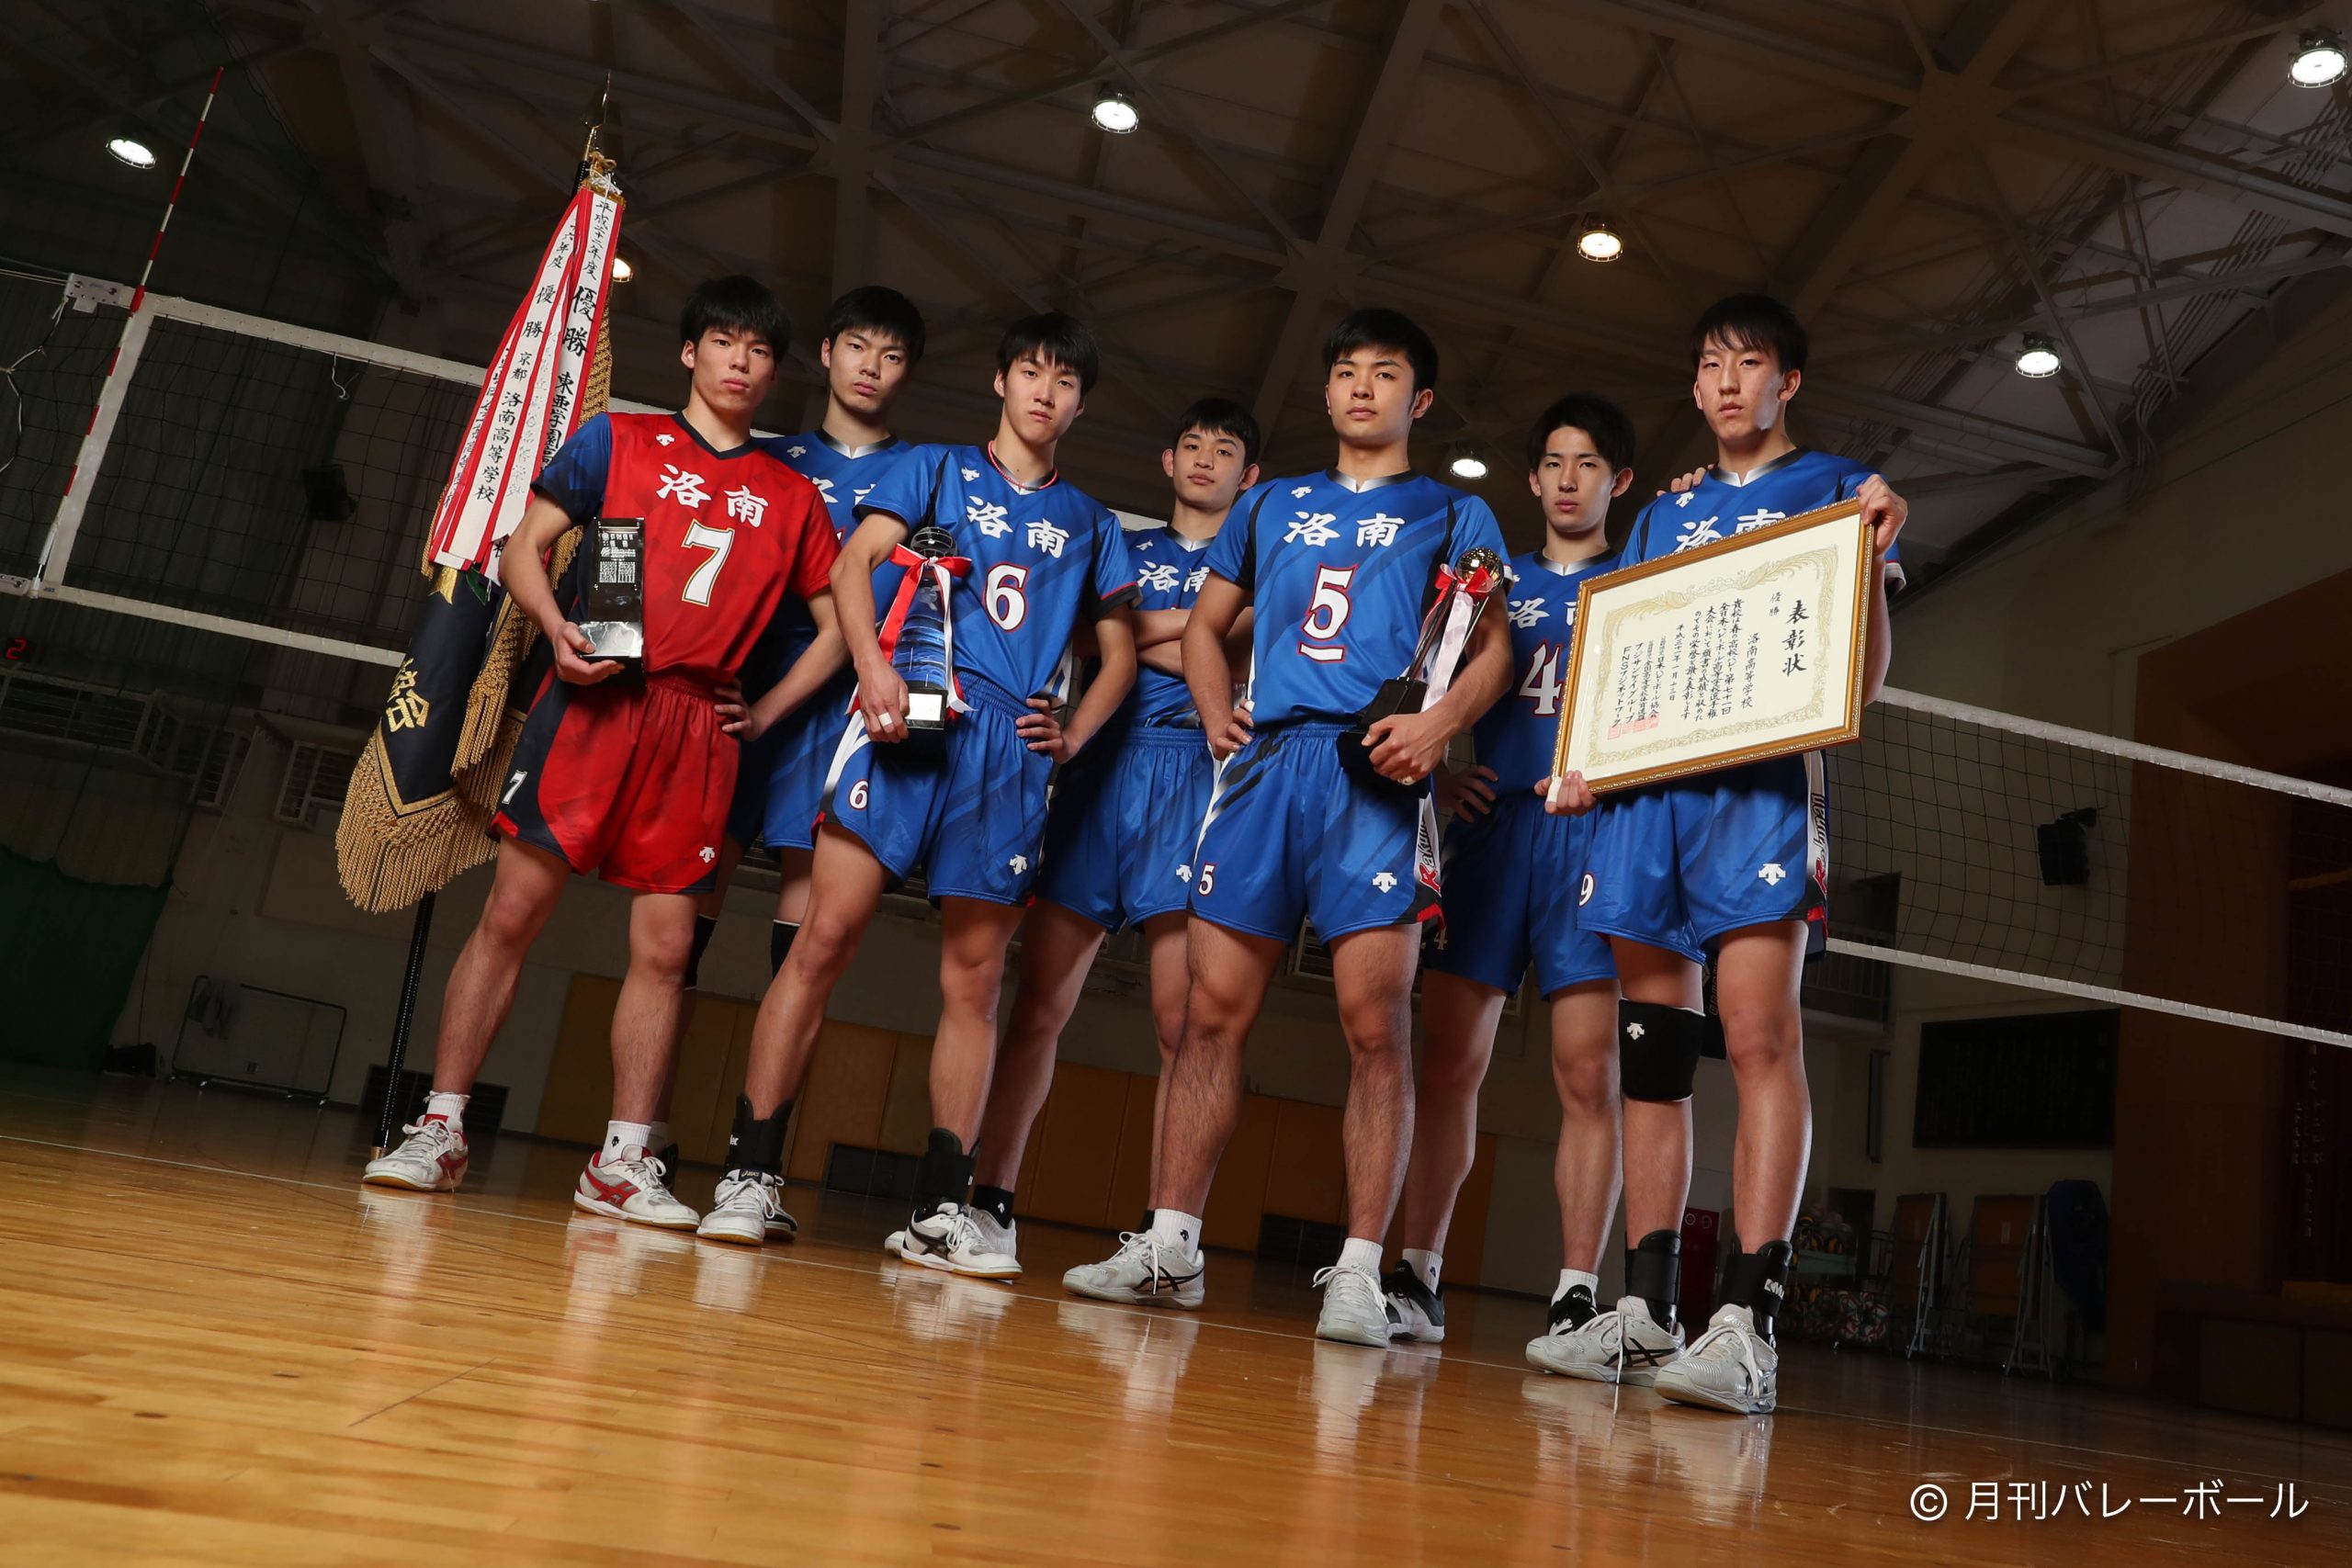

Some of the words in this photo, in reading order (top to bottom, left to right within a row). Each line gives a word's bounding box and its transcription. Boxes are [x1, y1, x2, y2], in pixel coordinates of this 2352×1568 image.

[522, 284, 556, 338] 優勝
[562, 286, 597, 357] 優勝
[511, 352, 532, 382] 京都
[474, 391, 523, 504] 洛南高等学校
[539, 371, 574, 475] 東亜学園高
[656, 463, 769, 528] 洛南
[966, 495, 1070, 558] 洛南
[1283, 511, 1406, 547] 洛南
[681, 518, 735, 607] 7
[984, 563, 1028, 632] 6
[1301, 563, 1357, 640] 5
[1509, 597, 1577, 629] 洛
[1770, 591, 1781, 617] 優勝
[1781, 599, 1810, 677] 表彰状
[1516, 640, 1563, 717] 4
[1741, 632, 1761, 709] 洛南高等学校
[502, 769, 528, 805] 7
[848, 779, 869, 810] 6
[1198, 863, 1216, 897] 5
[1578, 874, 1595, 907] 9
